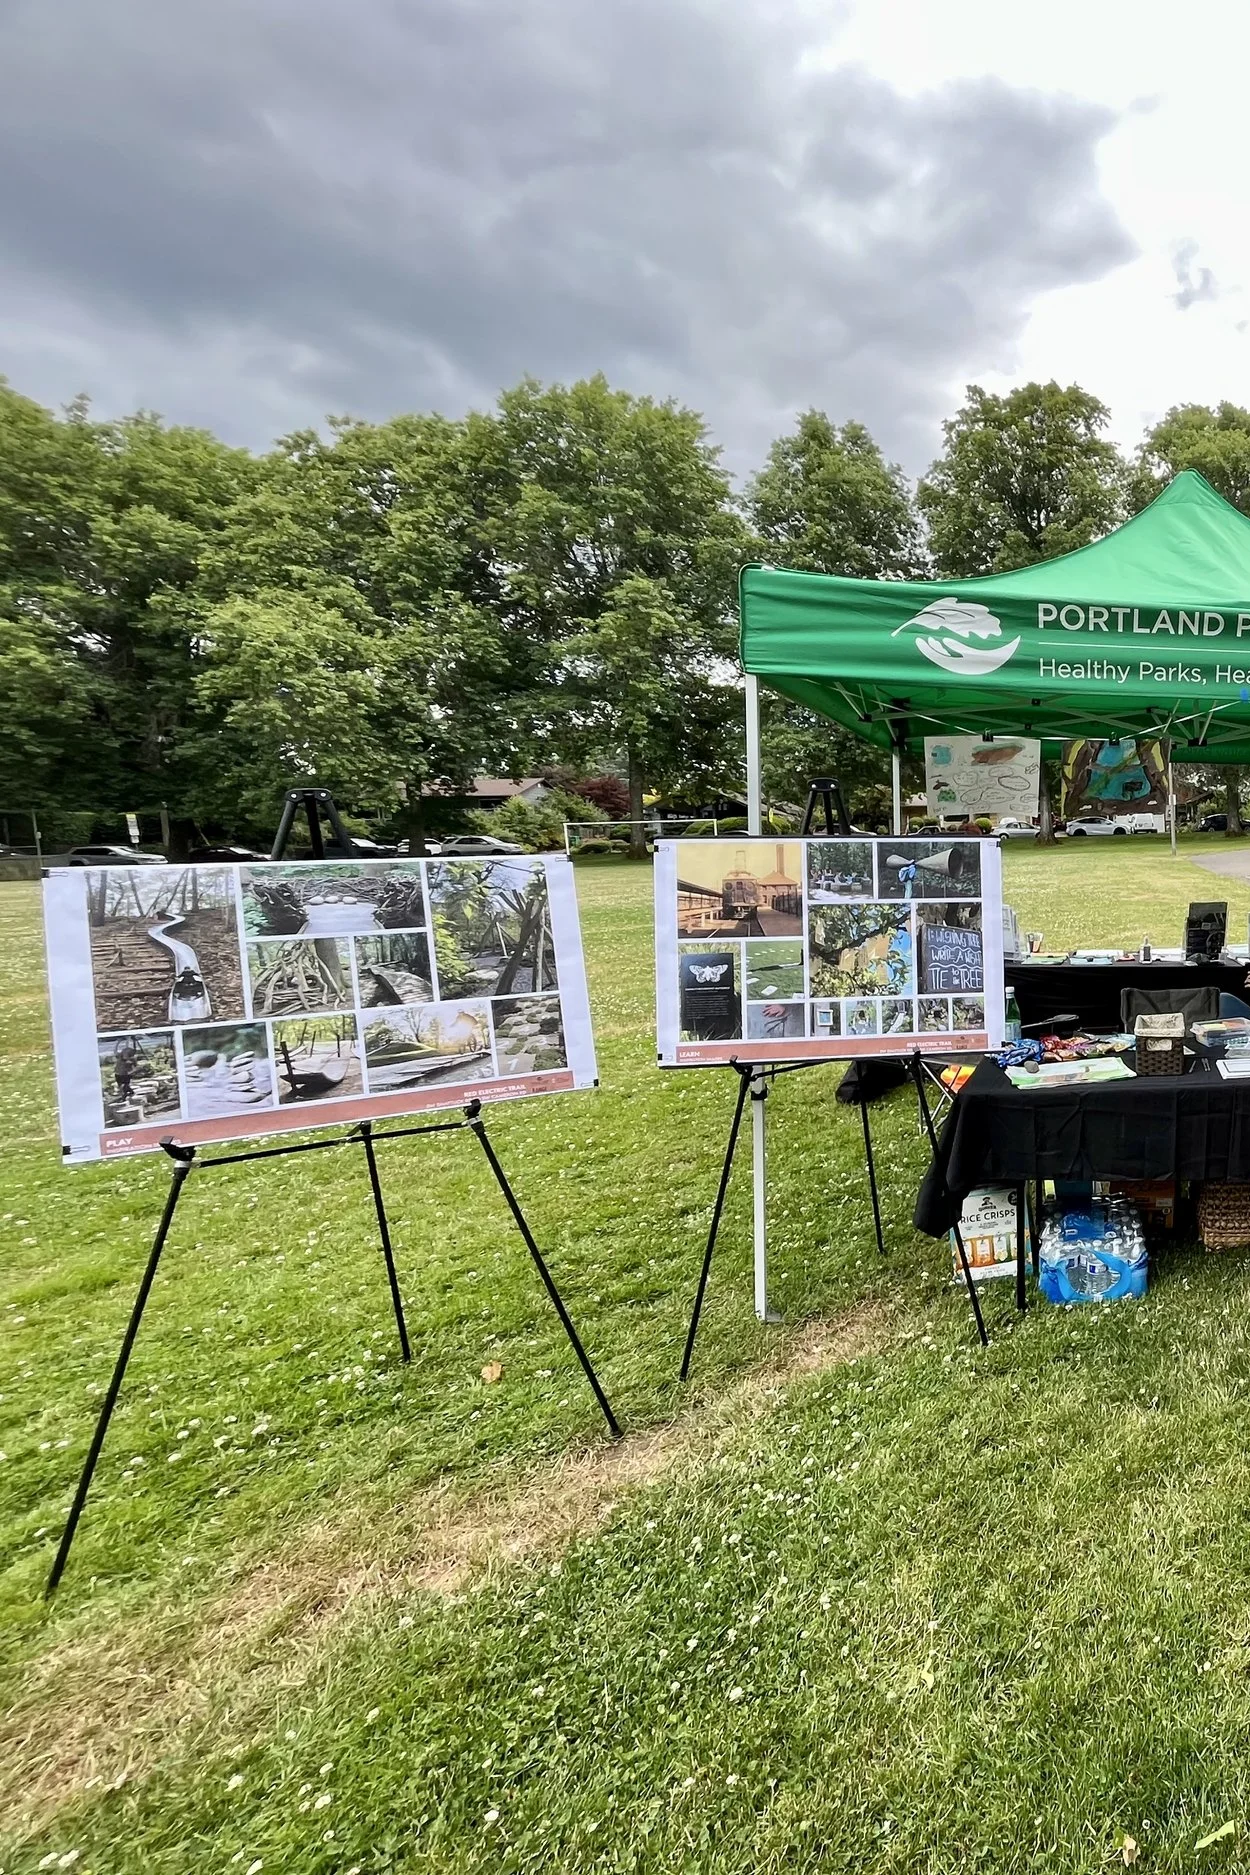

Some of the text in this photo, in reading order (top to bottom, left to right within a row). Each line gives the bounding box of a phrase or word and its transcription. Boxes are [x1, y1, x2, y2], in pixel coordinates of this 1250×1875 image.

[1038, 603, 1225, 637] PORTLAND
[1039, 658, 1130, 684] Healthy
[1139, 662, 1208, 686] Parks,
[464, 1090, 477, 1098] RED
[478, 1087, 508, 1096] ELECTRIC
[106, 1137, 133, 1148] PLAY
[961, 1208, 1015, 1224] RICE CRISPS
